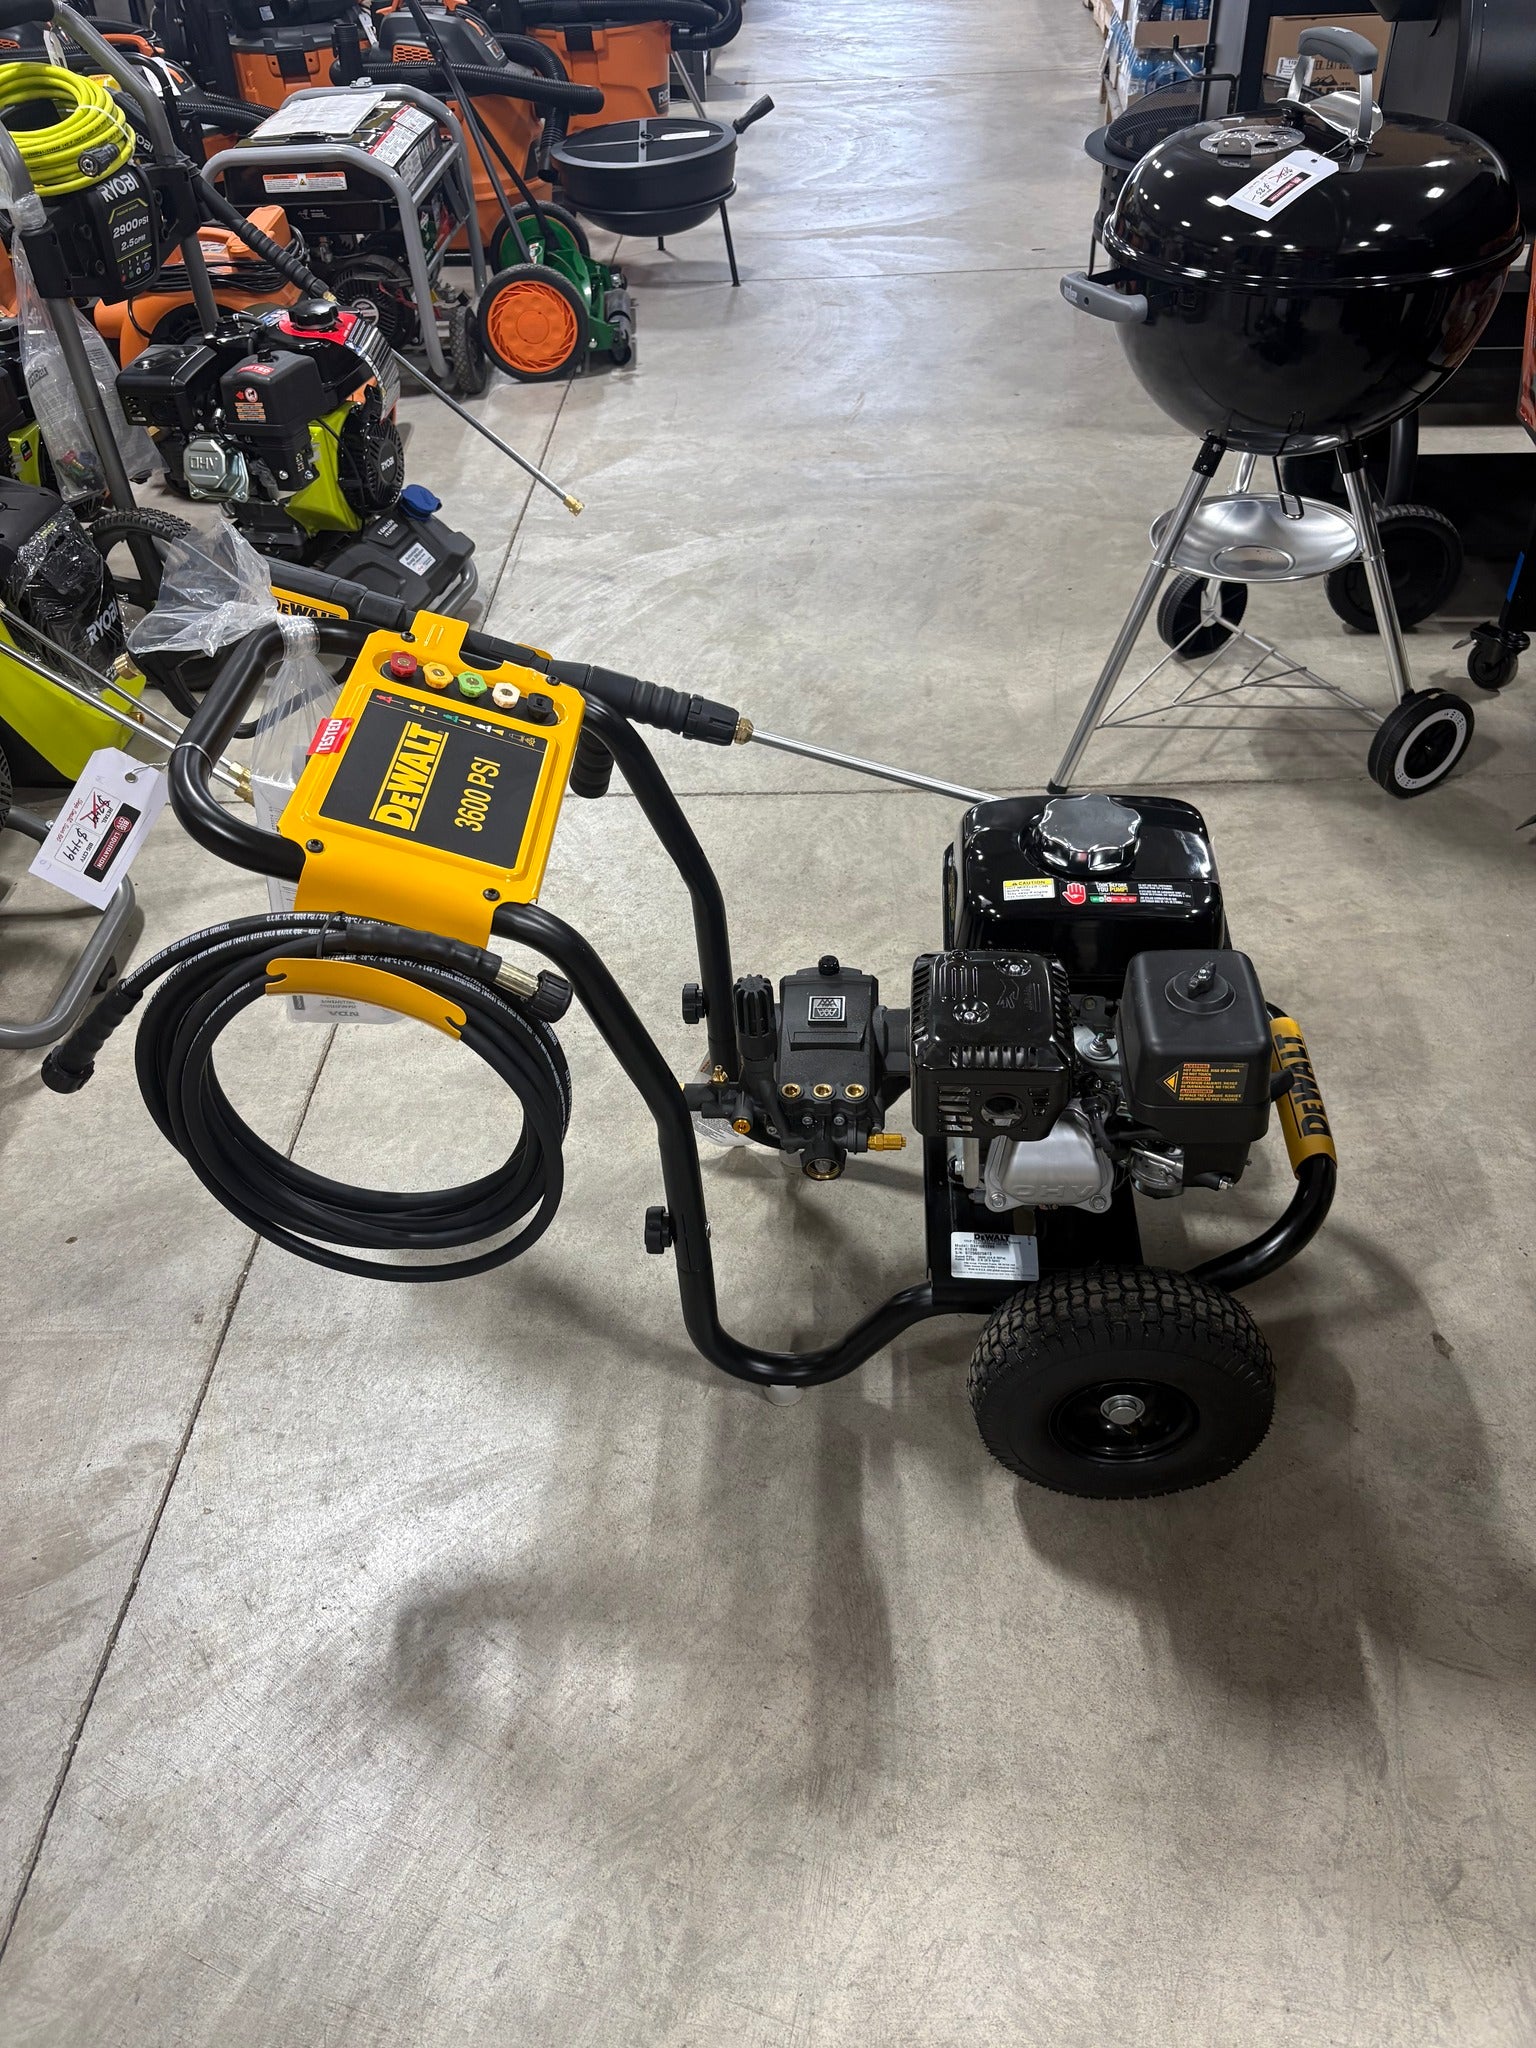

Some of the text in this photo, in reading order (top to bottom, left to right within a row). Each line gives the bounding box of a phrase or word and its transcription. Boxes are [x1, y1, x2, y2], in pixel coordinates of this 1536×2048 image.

[101, 172, 140, 203] RYOBI
[380, 456, 395, 472] RYOBI
[316, 719, 343, 753] TESTED
[454, 756, 501, 832] 3600 PSI
[101, 808, 114, 824] RETAIL
[62, 827, 89, 862] $449
[96, 832, 121, 868] LIQUIDATION
[1013, 1184, 1094, 1198] OHV
